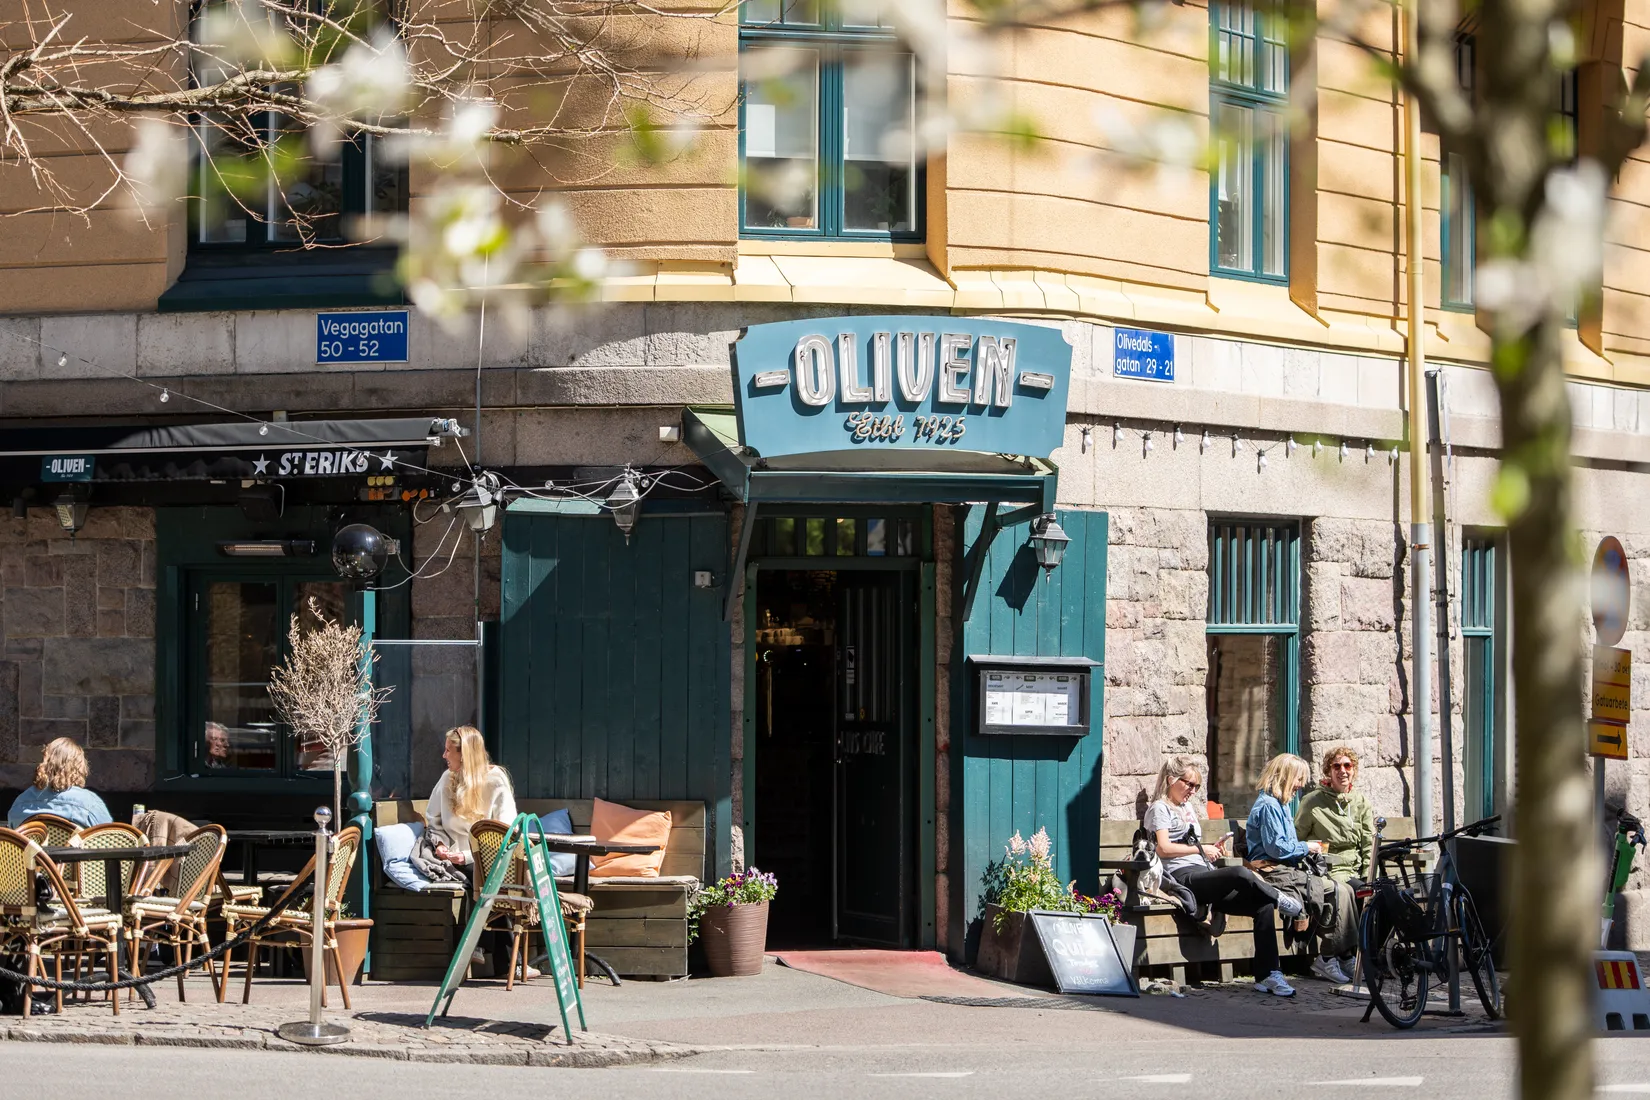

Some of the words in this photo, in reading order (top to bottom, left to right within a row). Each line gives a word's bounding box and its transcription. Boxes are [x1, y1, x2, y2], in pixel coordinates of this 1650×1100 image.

[320, 318, 404, 339] Vegagatan
[320, 341, 343, 358] 50
[359, 340, 379, 357] 52
[795, 331, 1018, 408] OLIVEN
[1116, 356, 1141, 374] gatan
[1146, 357, 1157, 374] 29
[1164, 359, 1174, 376] 21
[915, 415, 967, 438] 1925
[50, 458, 86, 474] OLIVEN
[303, 450, 371, 475] ERIKS
[1595, 693, 1628, 710] Gatuarbete
